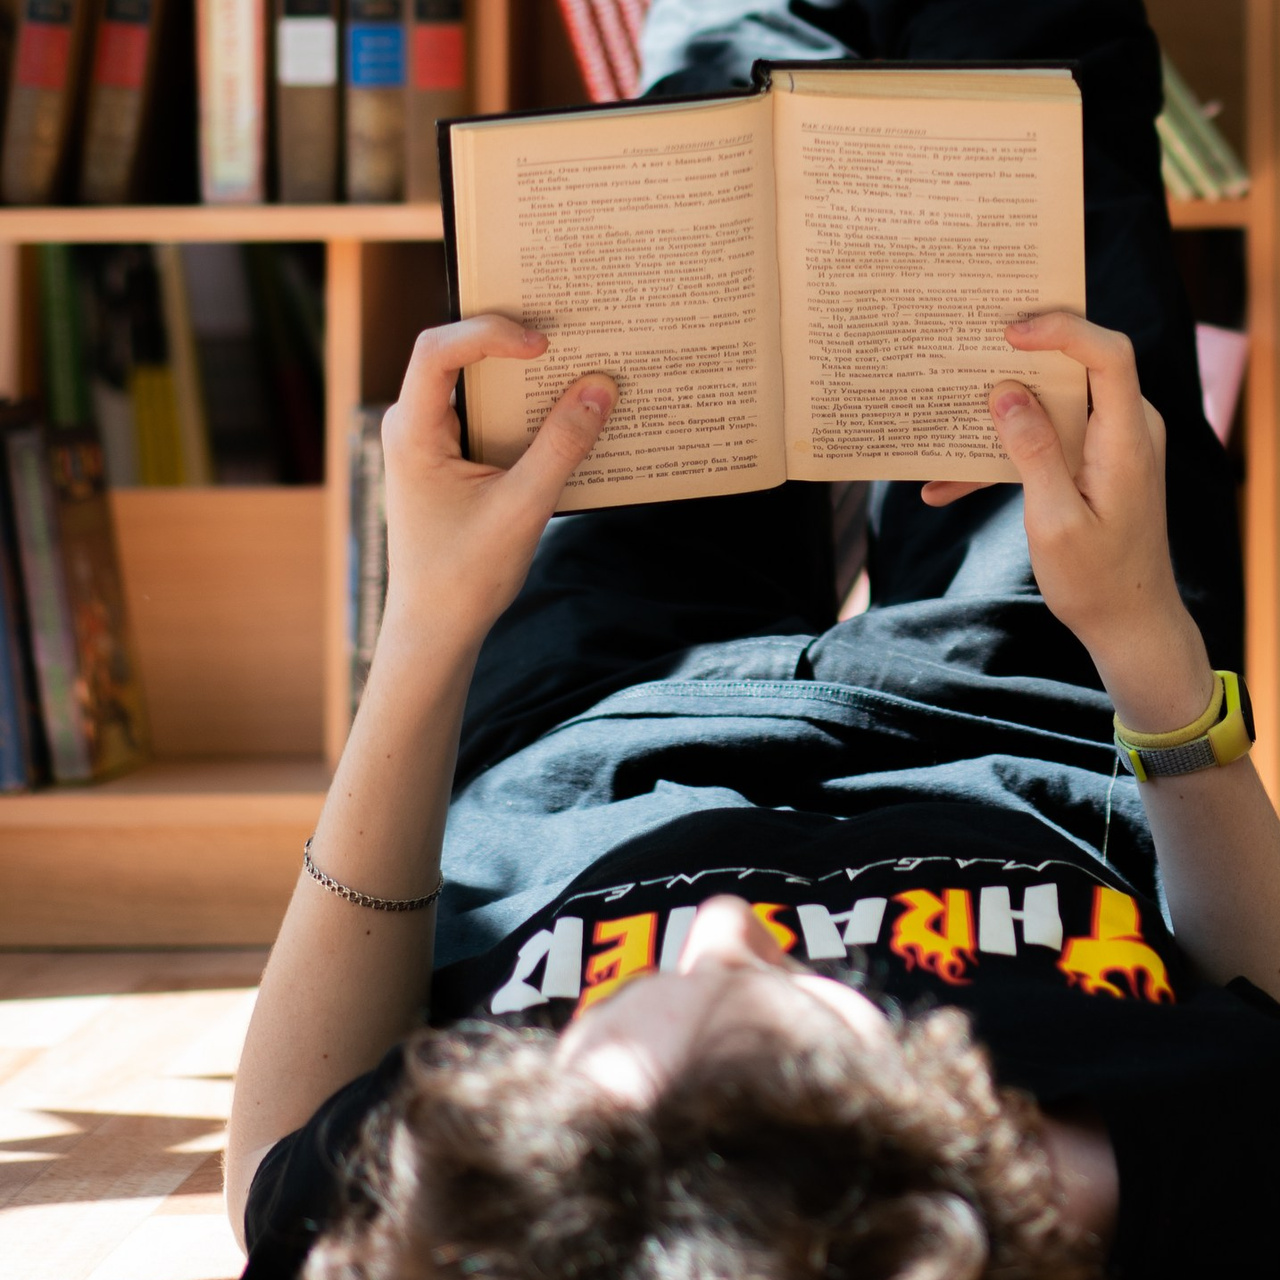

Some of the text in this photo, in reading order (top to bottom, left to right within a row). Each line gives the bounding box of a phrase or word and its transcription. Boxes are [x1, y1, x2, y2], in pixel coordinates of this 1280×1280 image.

[523, 367, 541, 375] рош
[572, 359, 601, 368] гонять!
[674, 384, 693, 392] тебя
[696, 382, 739, 390] ложиться,
[821, 387, 837, 395] Тут
[840, 387, 876, 395] Упырева
[936, 384, 980, 392] свистнула.
[619, 397, 650, 405] Смерть
[677, 394, 693, 402] уже
[936, 393, 976, 401] прыгнут
[636, 403, 693, 413] рассыпчатая.
[739, 396, 757, 404] ней,
[831, 403, 862, 411] Дубина
[863, 402, 888, 411] тушей
[860, 411, 901, 419] развернул
[912, 410, 932, 418] руки
[934, 409, 975, 417] заломил,
[640, 420, 665, 428] Князь
[686, 416, 725, 425] багровый
[835, 419, 847, 427] Ну
[951, 415, 980, 423] Упырь.
[606, 429, 662, 441] Добился-таки
[694, 424, 725, 432] хитрый
[727, 422, 757, 430] Упырь.
[810, 427, 841, 435] Дубина
[961, 423, 988, 431] Клюв
[811, 435, 835, 443] ребра
[595, 450, 632, 458] набычил,
[634, 445, 675, 454] по-волчьи
[677, 442, 710, 450] зарычал
[967, 450, 1000, 458] братва,
[577, 469, 605, 477] двоих,
[654, 460, 679, 469] собой
[680, 459, 709, 467] уговор
[731, 454, 758, 462] Упырь
[586, 476, 605, 484] баба
[606, 474, 634, 482] вправо
[670, 467, 705, 476] свистнет
[588, 856, 1066, 904] MAGAZINE
[491, 883, 1175, 1017] THRAER
